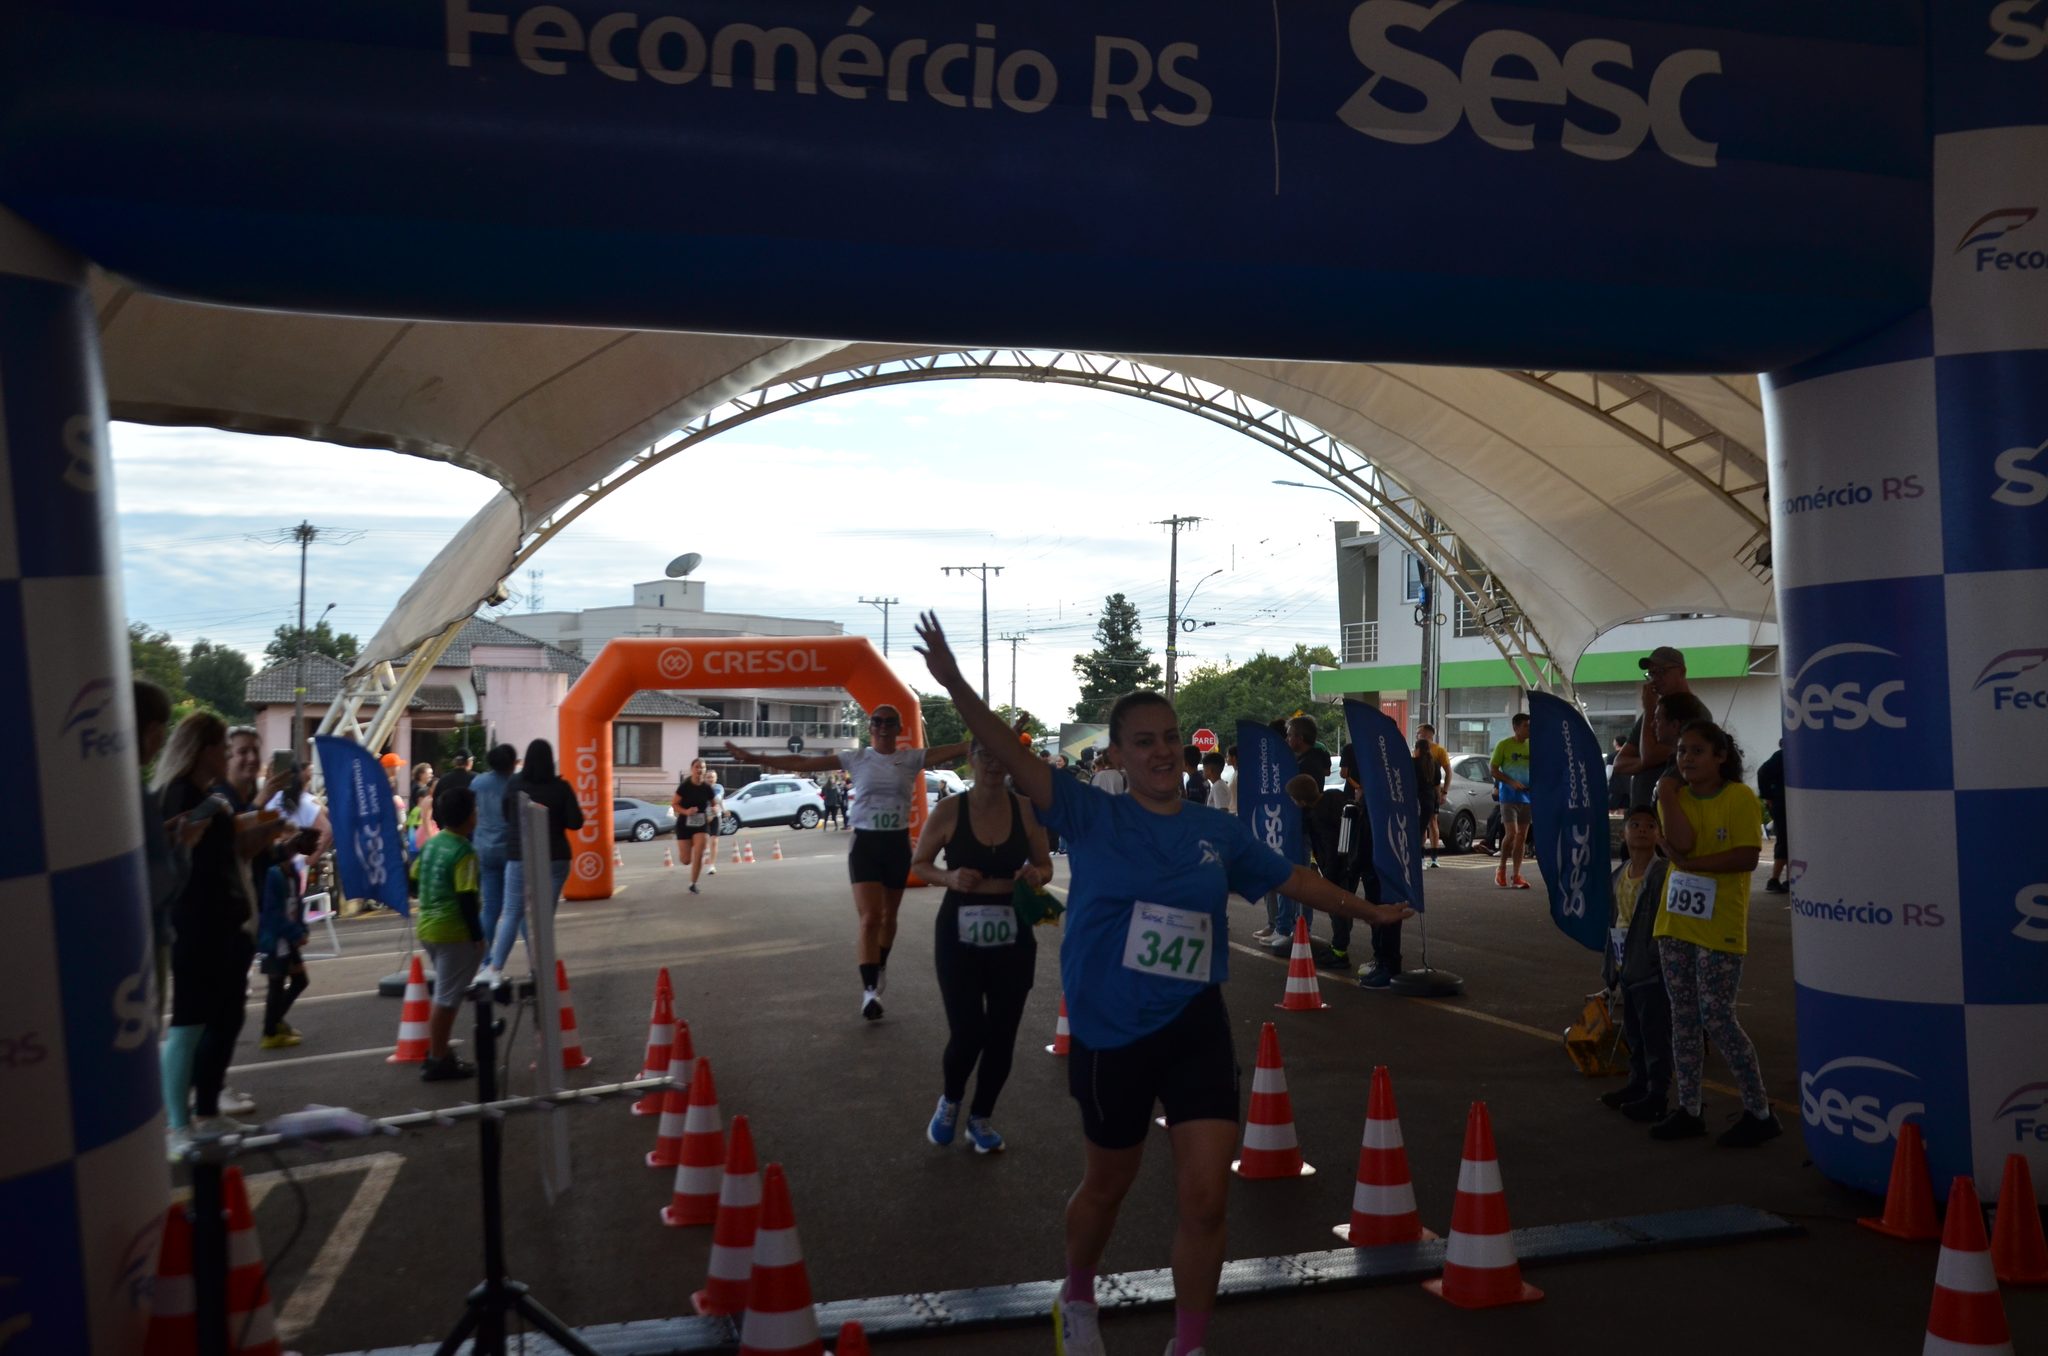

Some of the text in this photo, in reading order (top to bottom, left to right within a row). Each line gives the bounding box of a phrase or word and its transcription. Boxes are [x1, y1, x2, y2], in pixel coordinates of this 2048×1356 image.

[447, 0, 1213, 127] Fecomércio RS
[1336, 0, 1722, 168] Sesc
[1977, 247, 2048, 272] Feco
[1882, 474, 1925, 500] RS
[703, 649, 827, 674] CRESOL
[1194, 737, 1214, 745] PARE
[1561, 719, 1579, 809] Fecomércio
[577, 738, 598, 843] CRESOL
[872, 813, 900, 828] 102
[1562, 824, 1592, 919] Sesc
[1902, 904, 1945, 927] RS
[969, 921, 1011, 942] 100
[1137, 930, 1205, 974] 347
